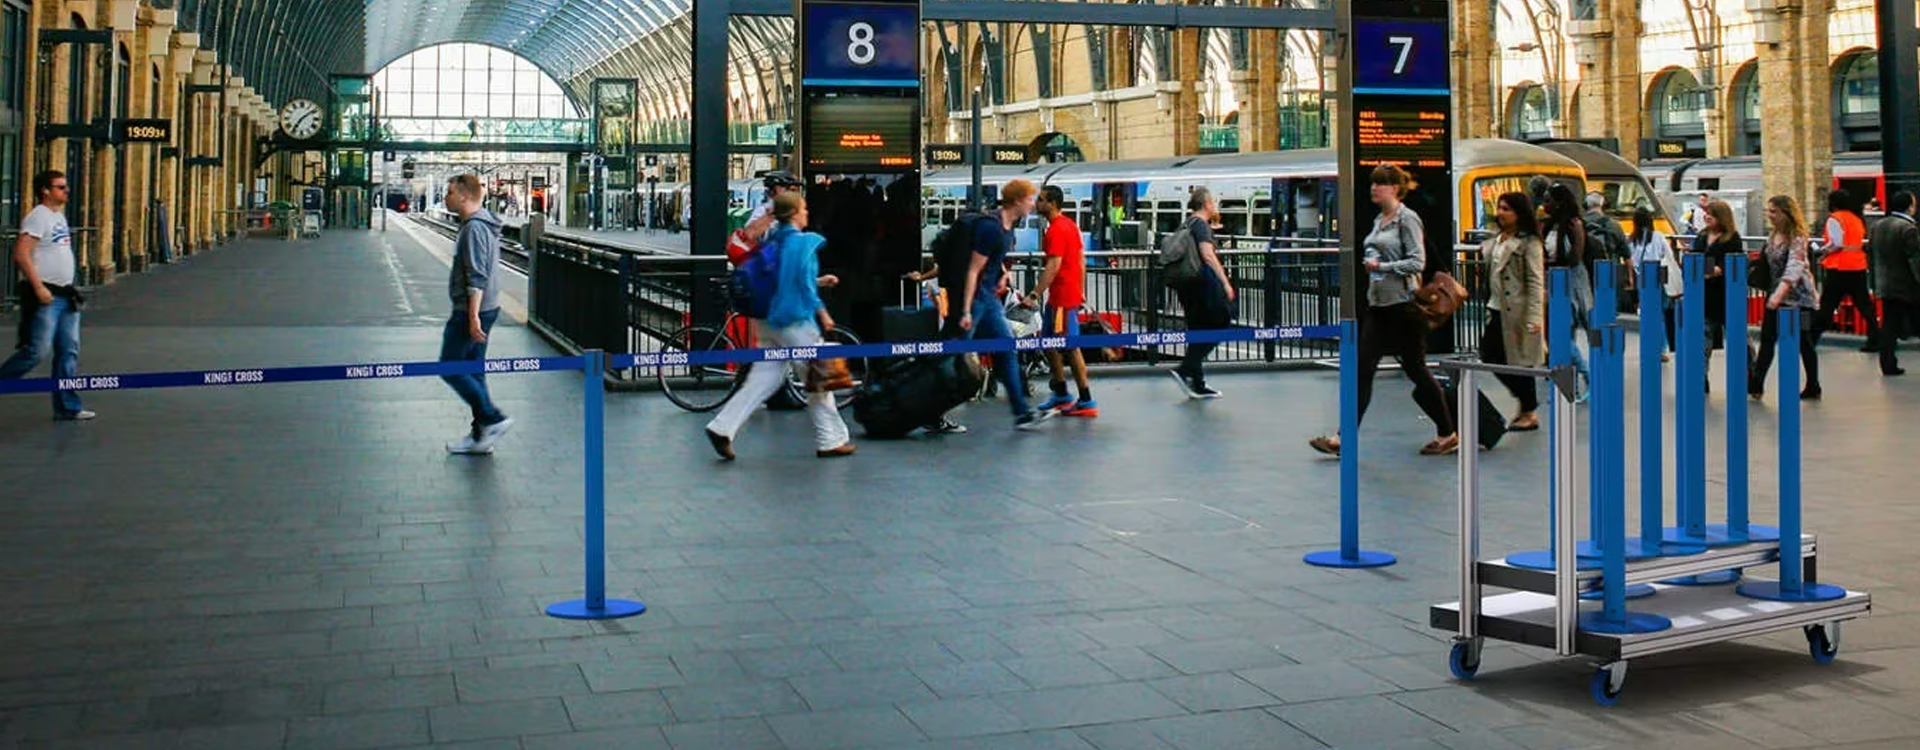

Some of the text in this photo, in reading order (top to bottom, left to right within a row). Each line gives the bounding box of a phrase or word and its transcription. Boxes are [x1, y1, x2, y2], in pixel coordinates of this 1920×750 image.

[847, 22, 876, 64] 8
[1389, 36, 1413, 74] 7
[1162, 332, 1186, 343] CROSS
[1280, 327, 1303, 338] CROSS
[919, 342, 943, 353] CROSS
[1042, 337, 1066, 348] CROSS
[792, 347, 817, 358] CROSS
[514, 358, 540, 370] CROSS
[662, 353, 688, 364] CROSS
[376, 364, 404, 376] CROSS
[90, 377, 119, 388] CROSS
[235, 371, 264, 383] CROSS
